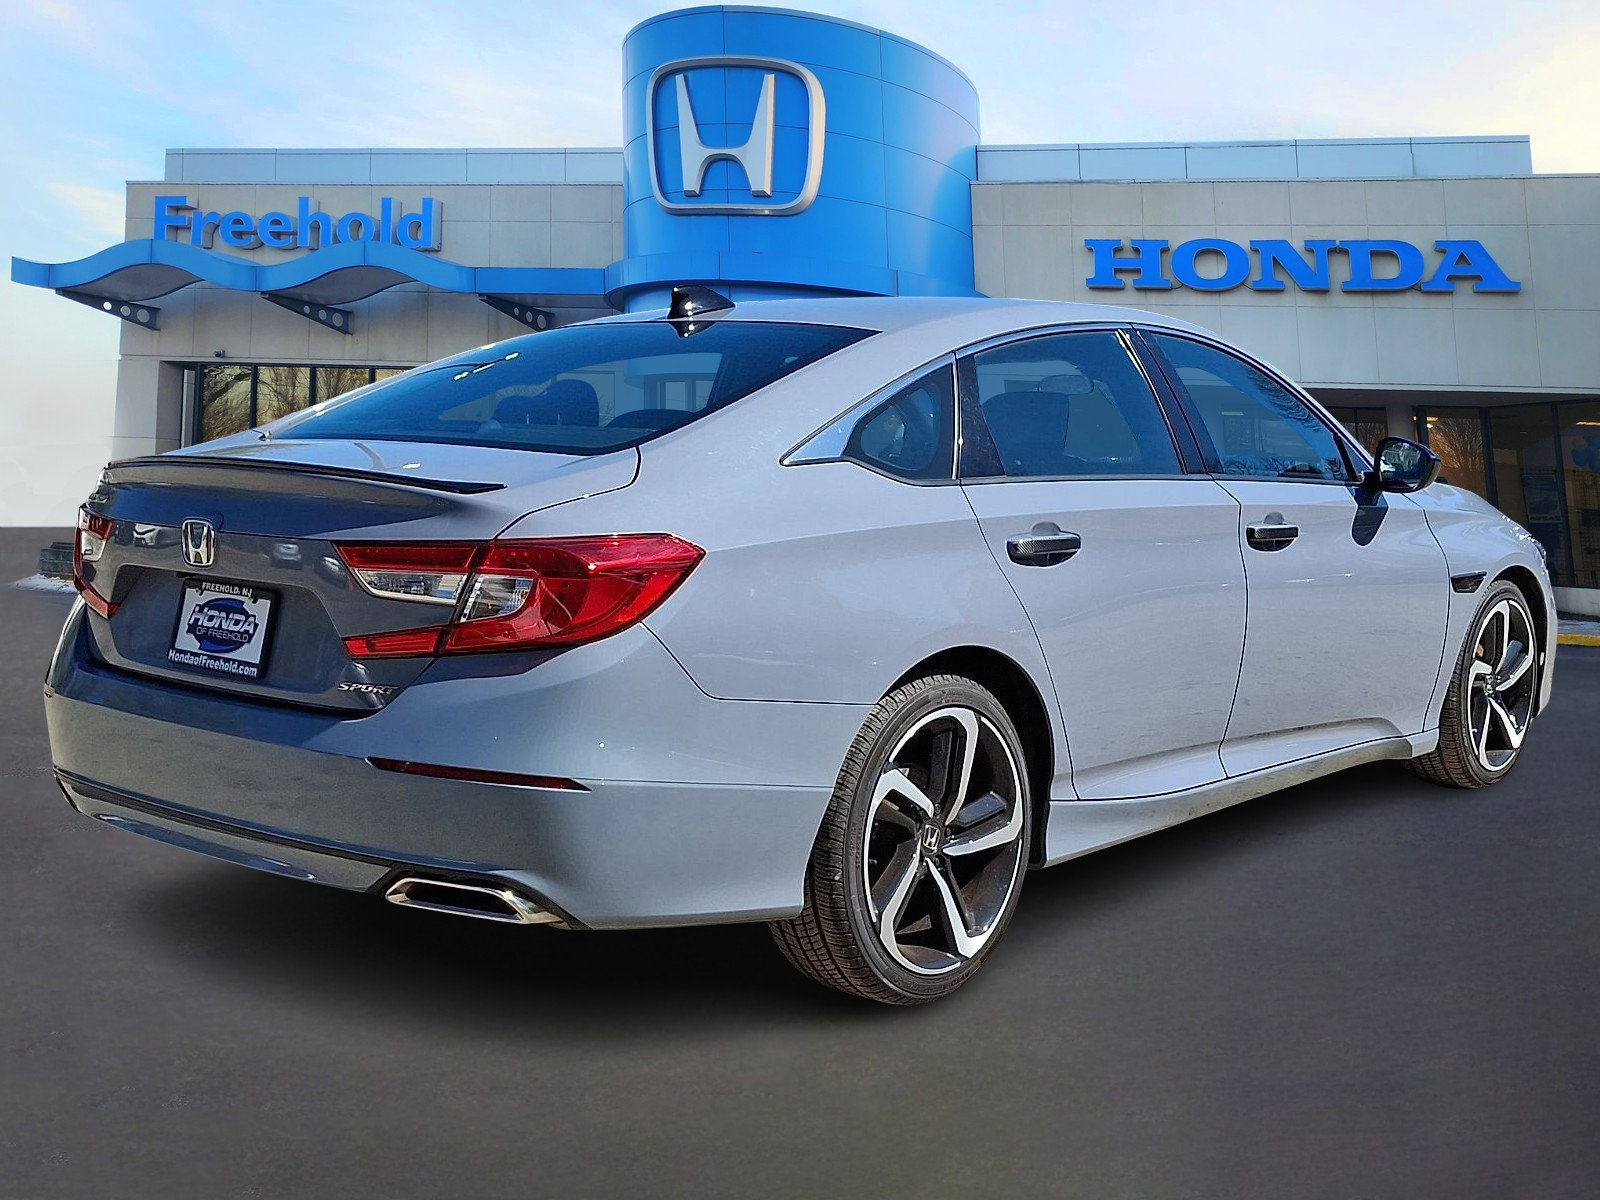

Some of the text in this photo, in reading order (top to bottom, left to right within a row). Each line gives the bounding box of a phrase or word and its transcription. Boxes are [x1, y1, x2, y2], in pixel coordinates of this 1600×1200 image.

[154, 195, 440, 249] Freehold
[1084, 238, 1521, 293] HONDA
[242, 588, 253, 597] NJ
[189, 605, 257, 634] HONDA
[196, 626, 249, 643] OF FREEHOLD
[168, 649, 258, 678] HondaofFreehold.com
[338, 682, 399, 695] SPORT
